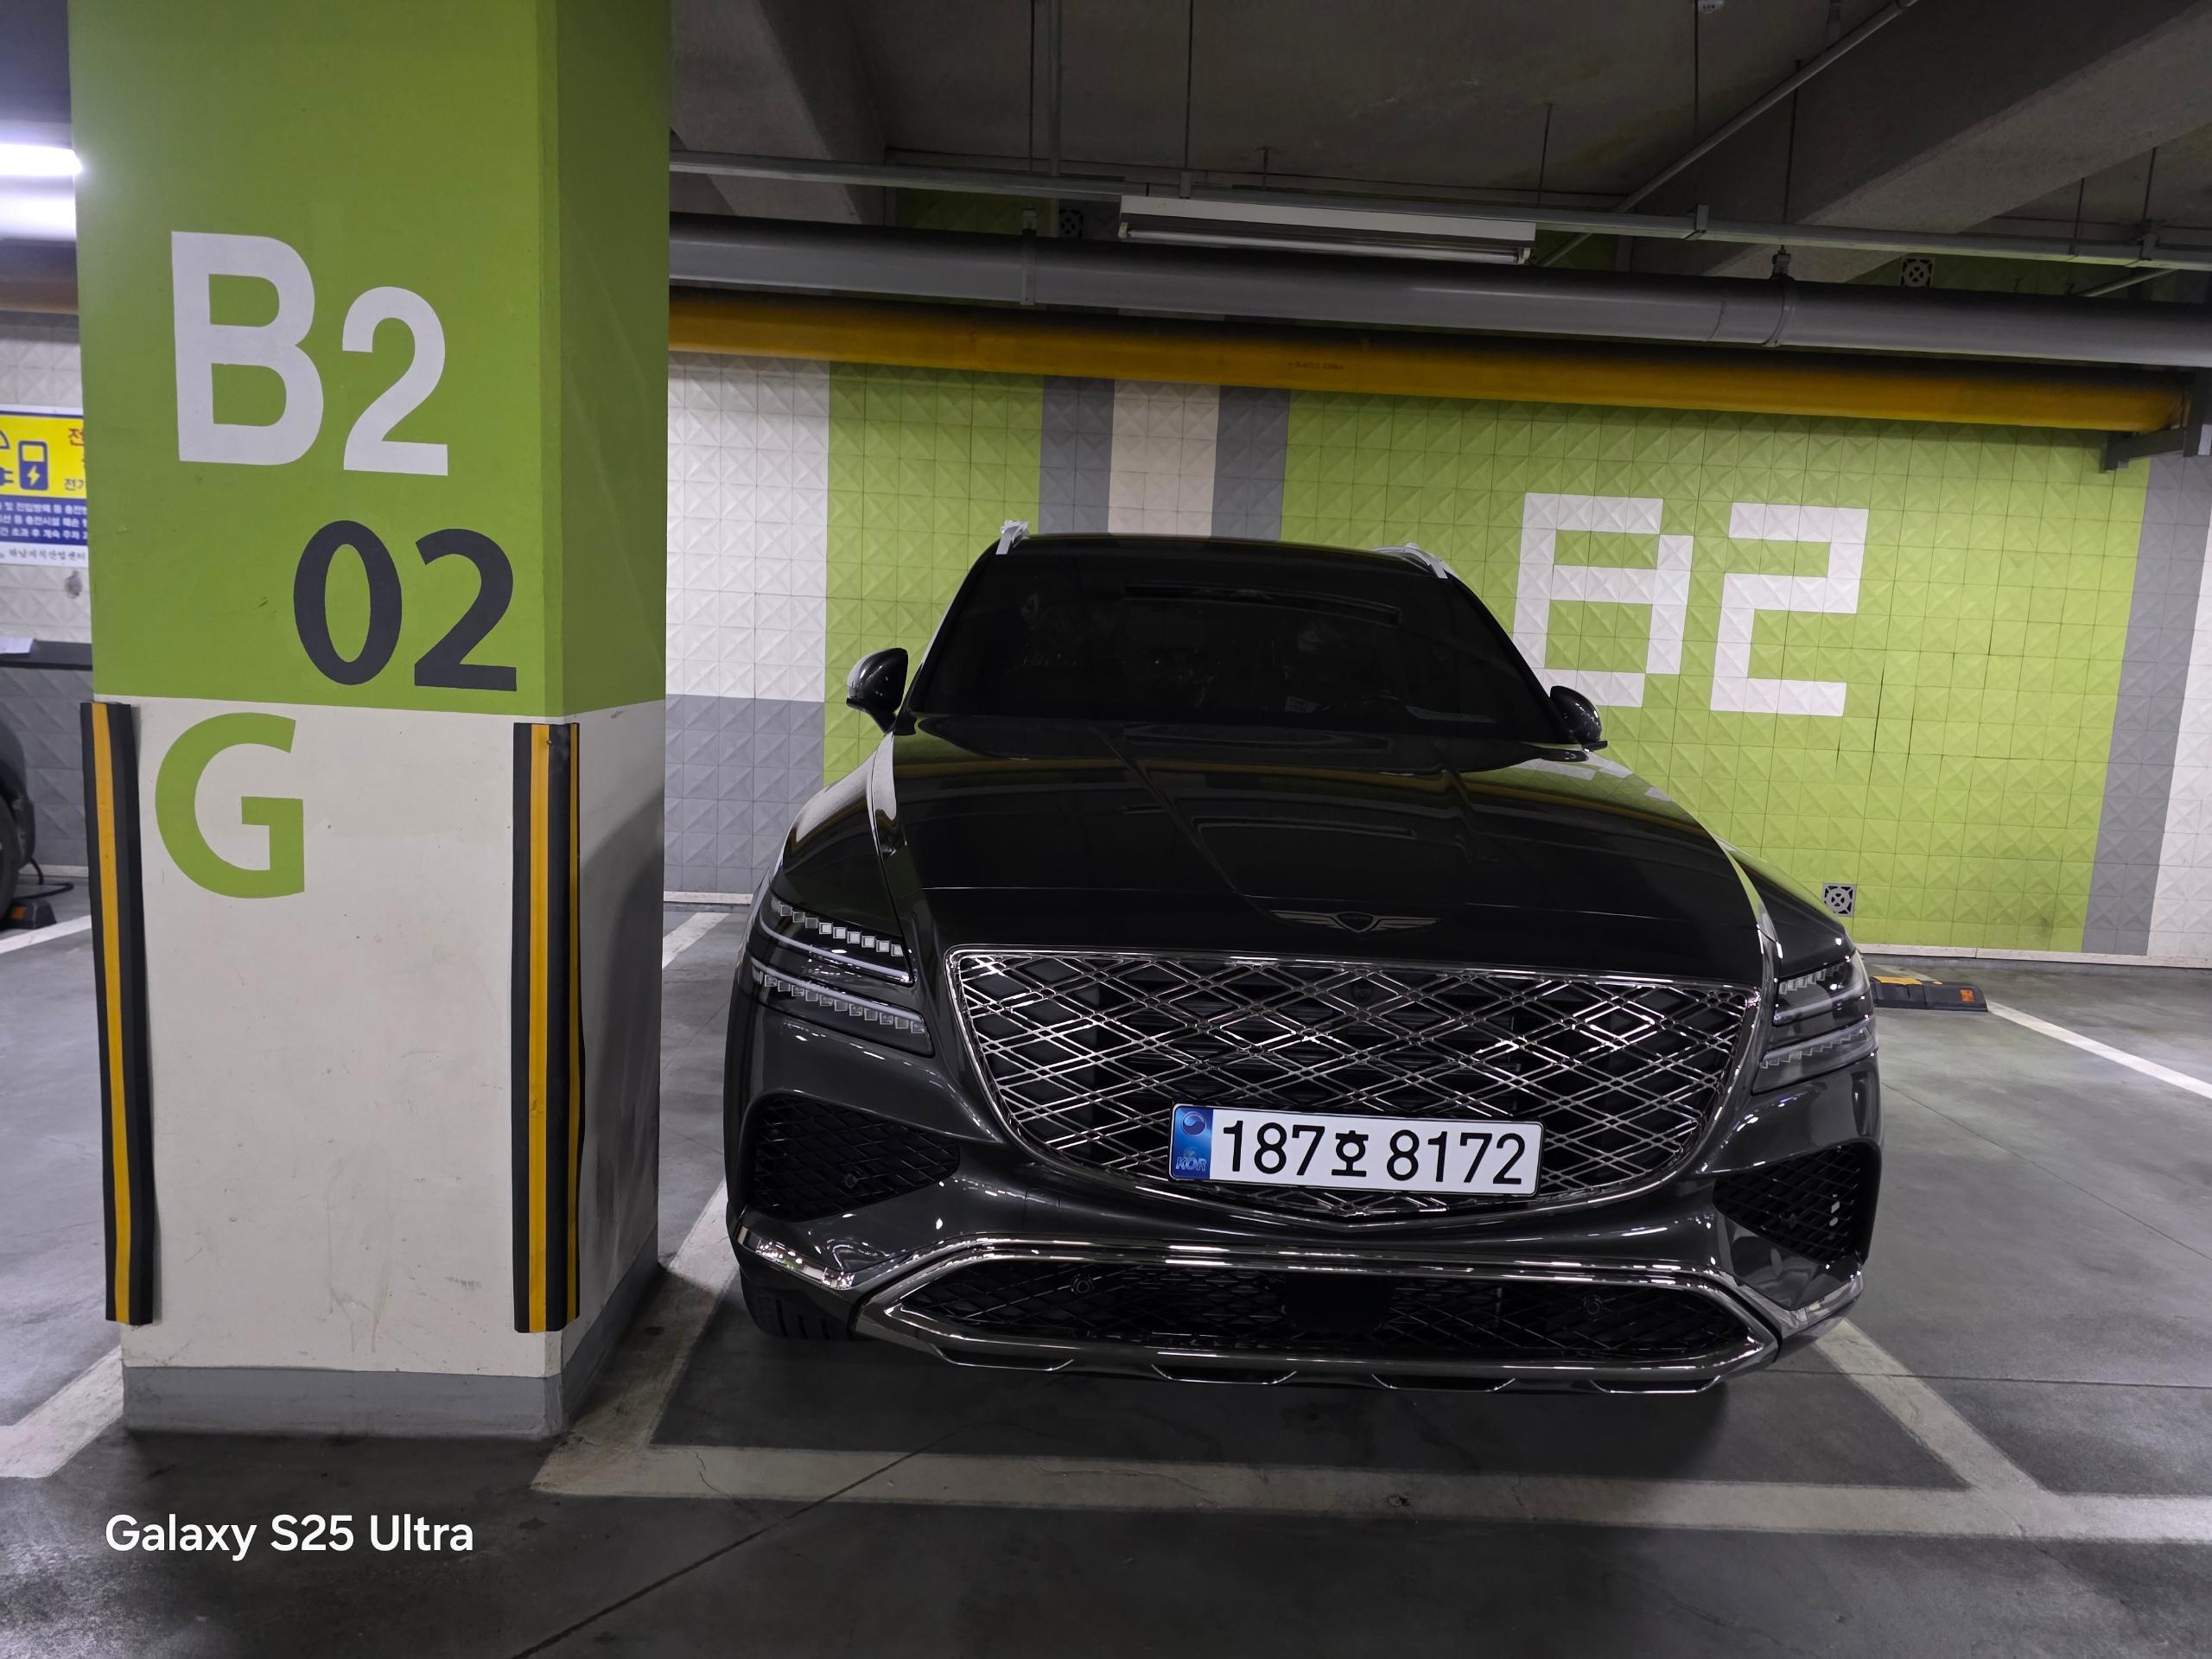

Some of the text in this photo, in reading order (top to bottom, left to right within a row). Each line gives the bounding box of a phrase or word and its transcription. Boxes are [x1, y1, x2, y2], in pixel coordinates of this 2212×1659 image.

[171, 231, 448, 476] B2
[294, 520, 518, 692] 02
[155, 712, 306, 899] G
[1175, 1156, 1207, 1172] KOR
[1223, 1120, 1526, 1185] 187호 8172
